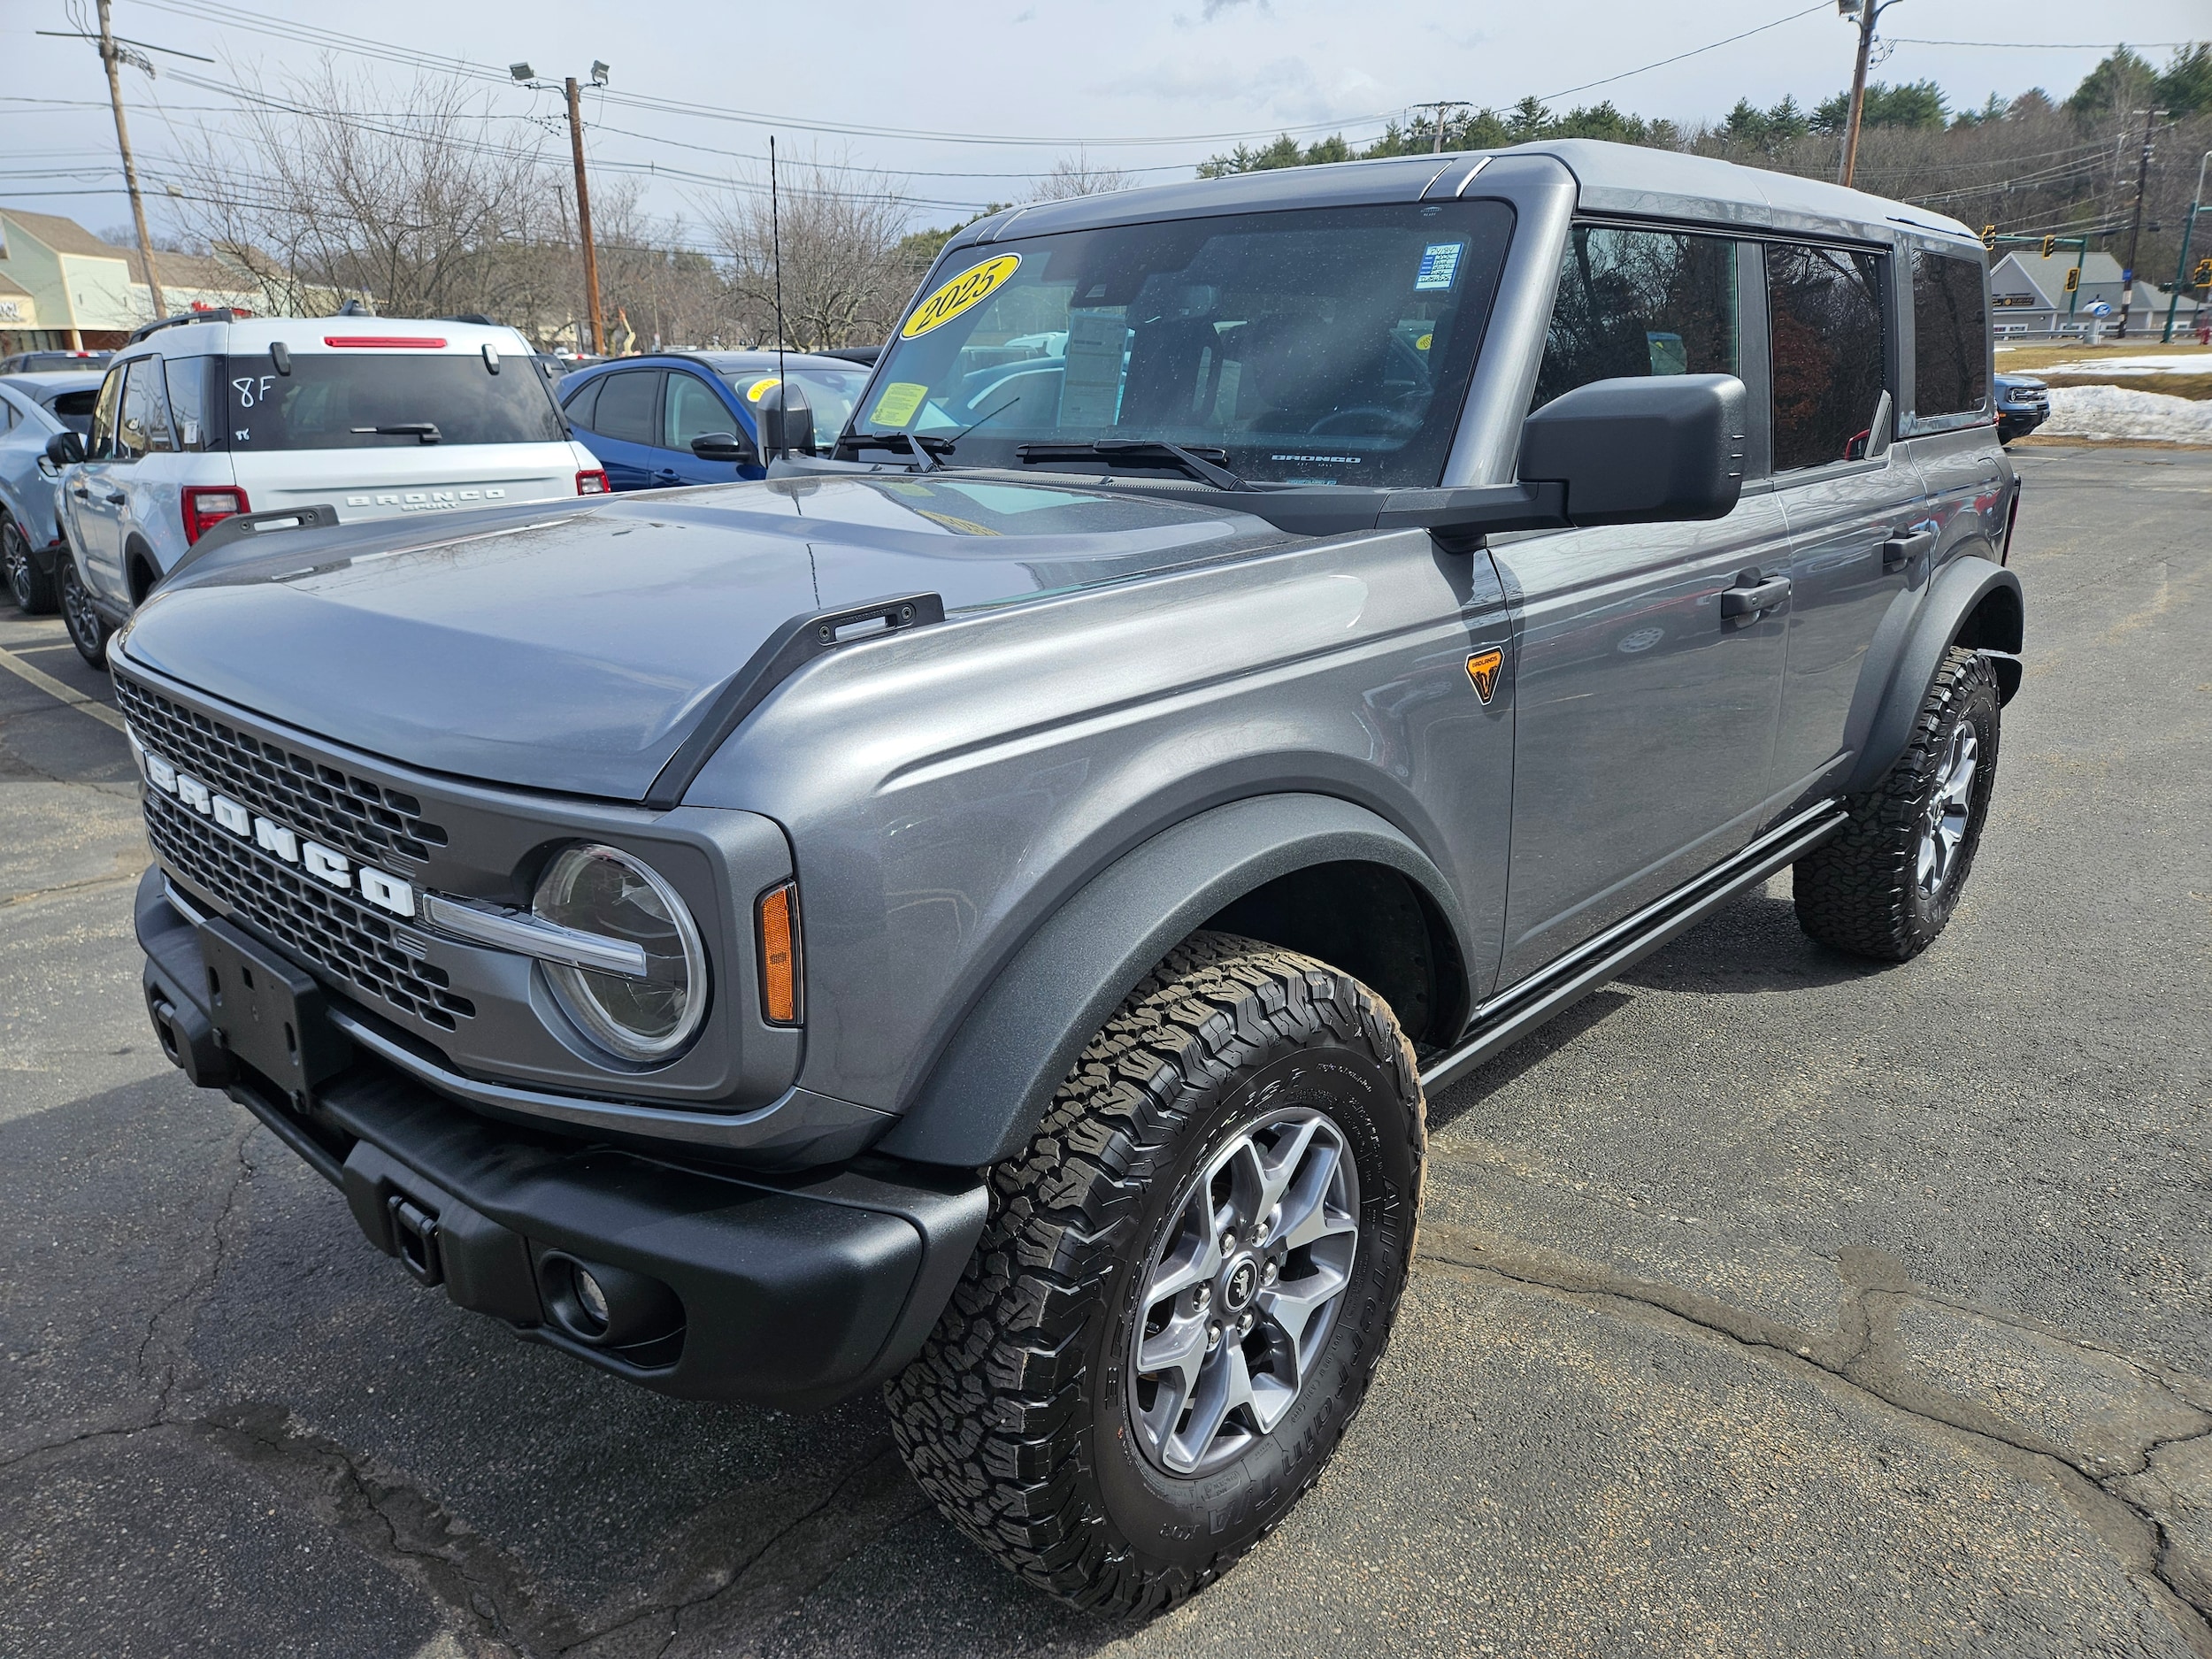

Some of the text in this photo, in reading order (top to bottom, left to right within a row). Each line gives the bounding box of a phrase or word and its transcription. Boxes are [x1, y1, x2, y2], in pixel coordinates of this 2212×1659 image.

[915, 261, 1003, 333] 2025
[1271, 455, 1362, 464] BRONCO
[347, 488, 506, 507] BRONCO
[401, 501, 459, 512] SPORT
[1472, 656, 1498, 667] BADLANDS
[149, 755, 416, 918] BRONCO
